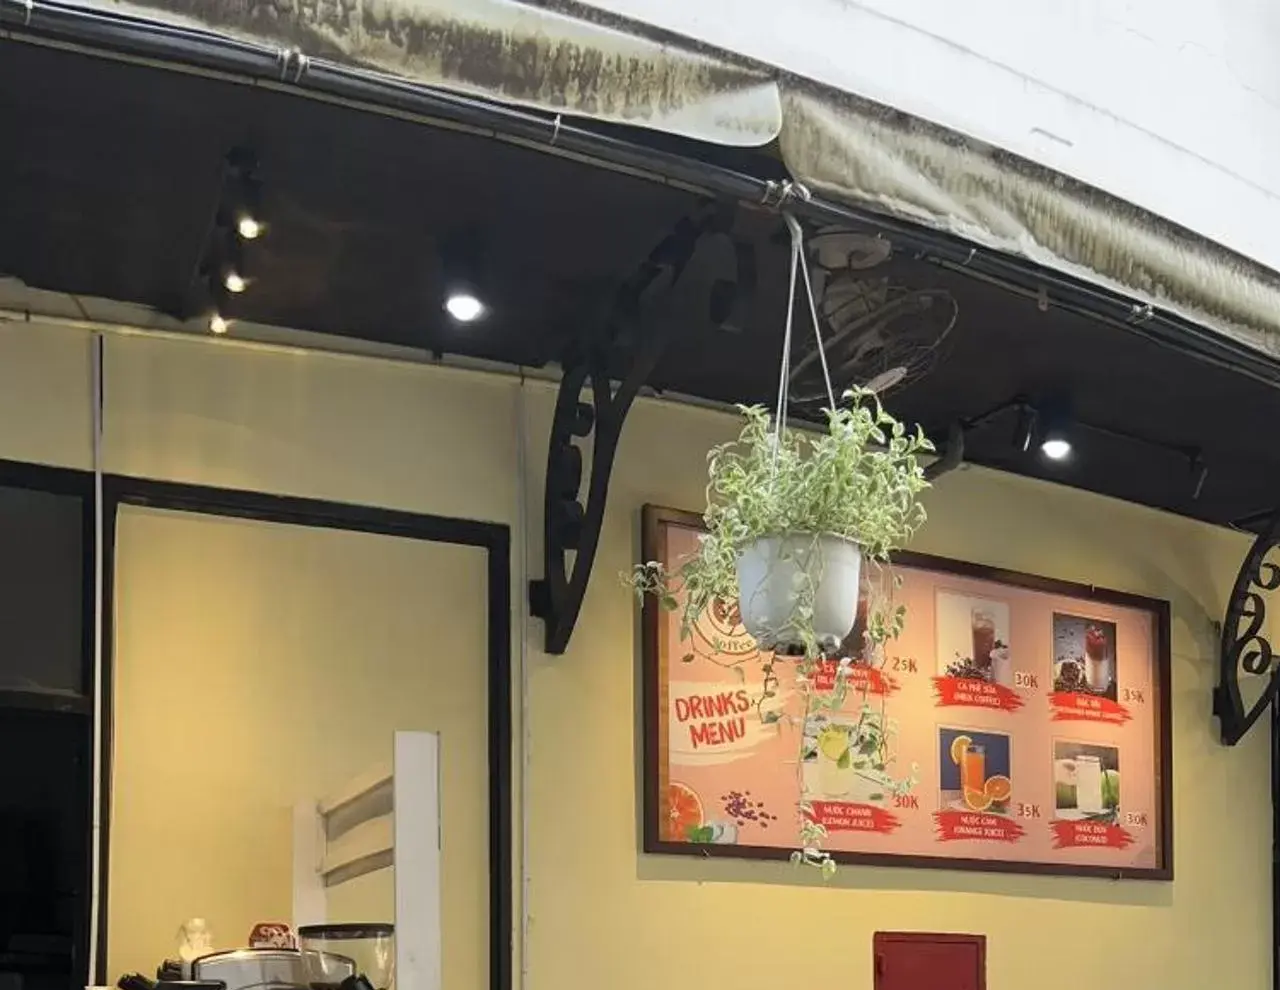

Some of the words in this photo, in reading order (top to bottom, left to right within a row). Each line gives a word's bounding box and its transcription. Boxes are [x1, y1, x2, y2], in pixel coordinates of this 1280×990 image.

[891, 656, 919, 673] 25K
[1015, 672, 1039, 689] 30K
[675, 689, 750, 723] DRINKS
[689, 717, 746, 749] MENU
[894, 794, 919, 810] 30K
[1017, 803, 1041, 818] 35K
